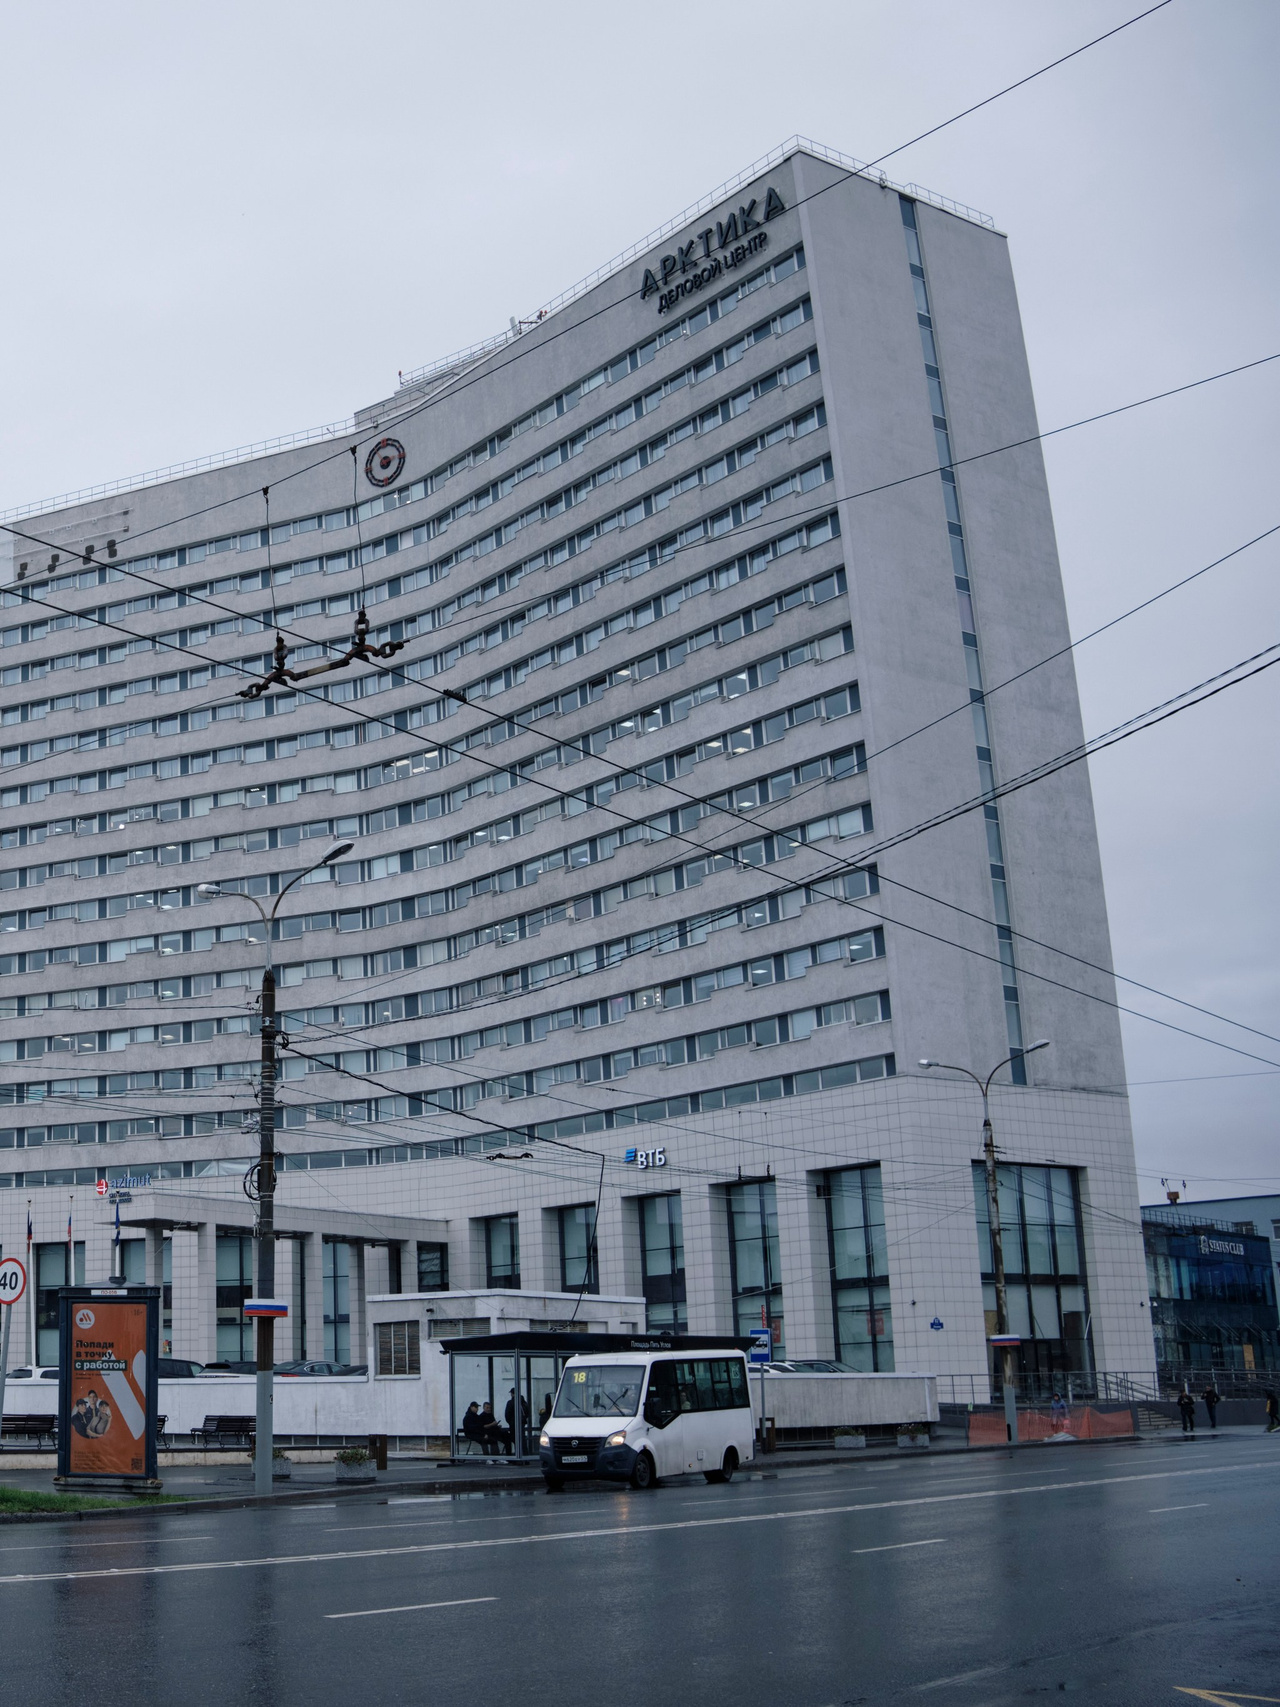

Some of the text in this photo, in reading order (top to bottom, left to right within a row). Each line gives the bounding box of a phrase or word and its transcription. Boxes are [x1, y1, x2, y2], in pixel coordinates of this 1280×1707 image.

[640, 186, 786, 300] АРКТИКА
[657, 231, 768, 315] ДЕЛОВОЙ ЦЕНТР
[637, 1147, 666, 1169] ВТБ
[111, 1173, 152, 1188] azimut
[1209, 1240, 1245, 1255] STATUS CLUB
[76, 1340, 114, 1349] Попади
[85, 1351, 113, 1359] точку
[84, 1360, 125, 1370] работой
[574, 1372, 586, 1383] 18
